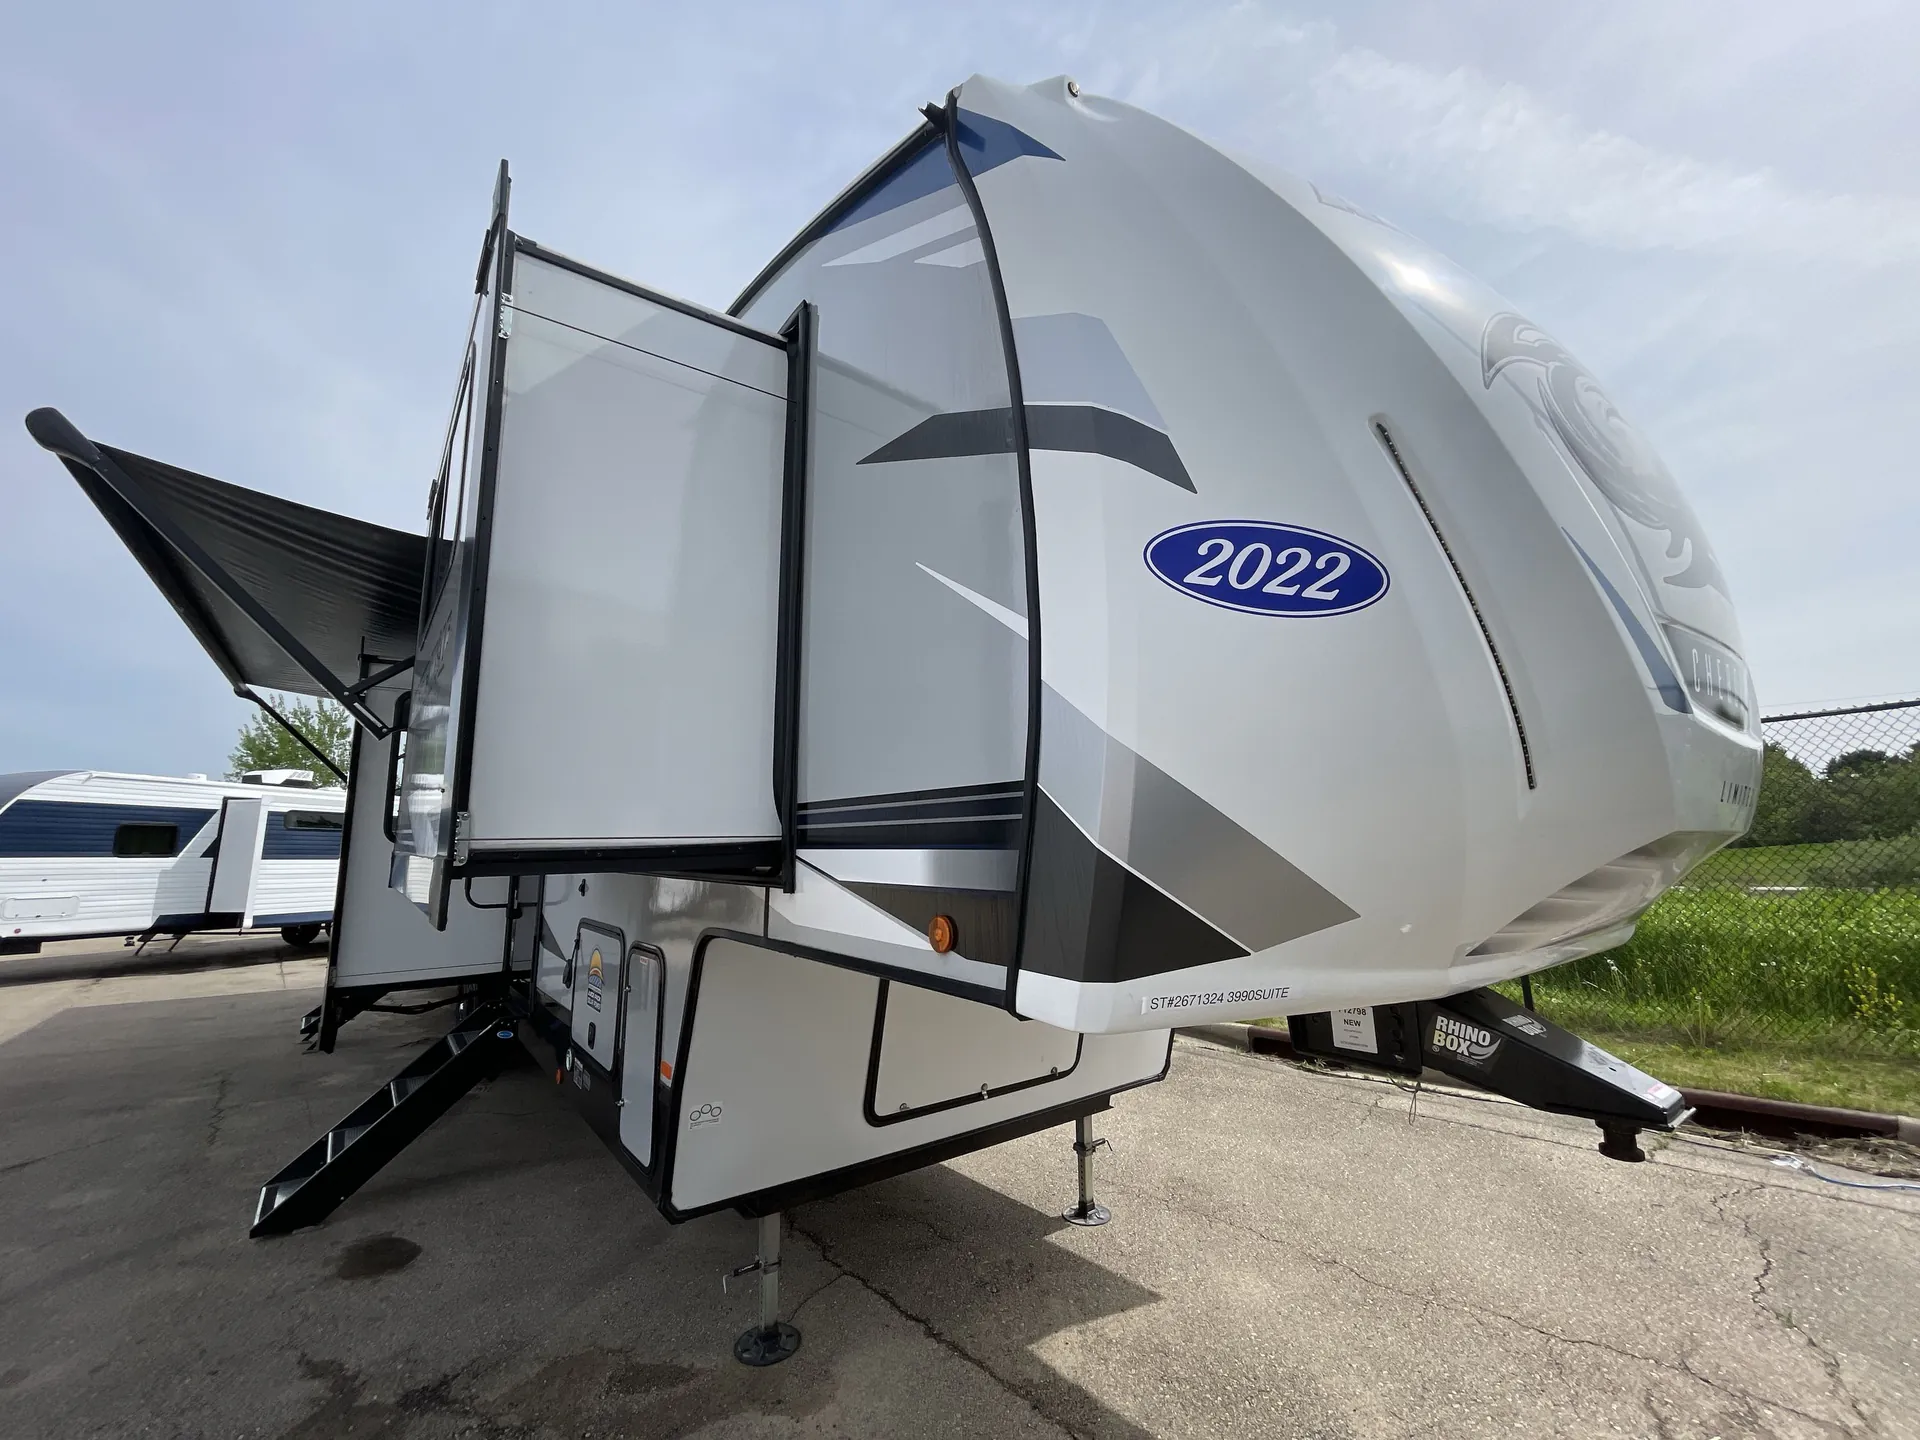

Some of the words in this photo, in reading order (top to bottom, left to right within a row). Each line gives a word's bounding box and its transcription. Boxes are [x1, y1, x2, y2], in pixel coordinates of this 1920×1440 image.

[1183, 538, 1351, 601] 2022
[1150, 992, 1224, 1010] ST#2671324
[1226, 986, 1290, 1003] 3990SUITE
[1343, 1018, 1361, 1027] NEW
[1435, 1015, 1491, 1046] RHINO
[1432, 1029, 1471, 1057] BOX
